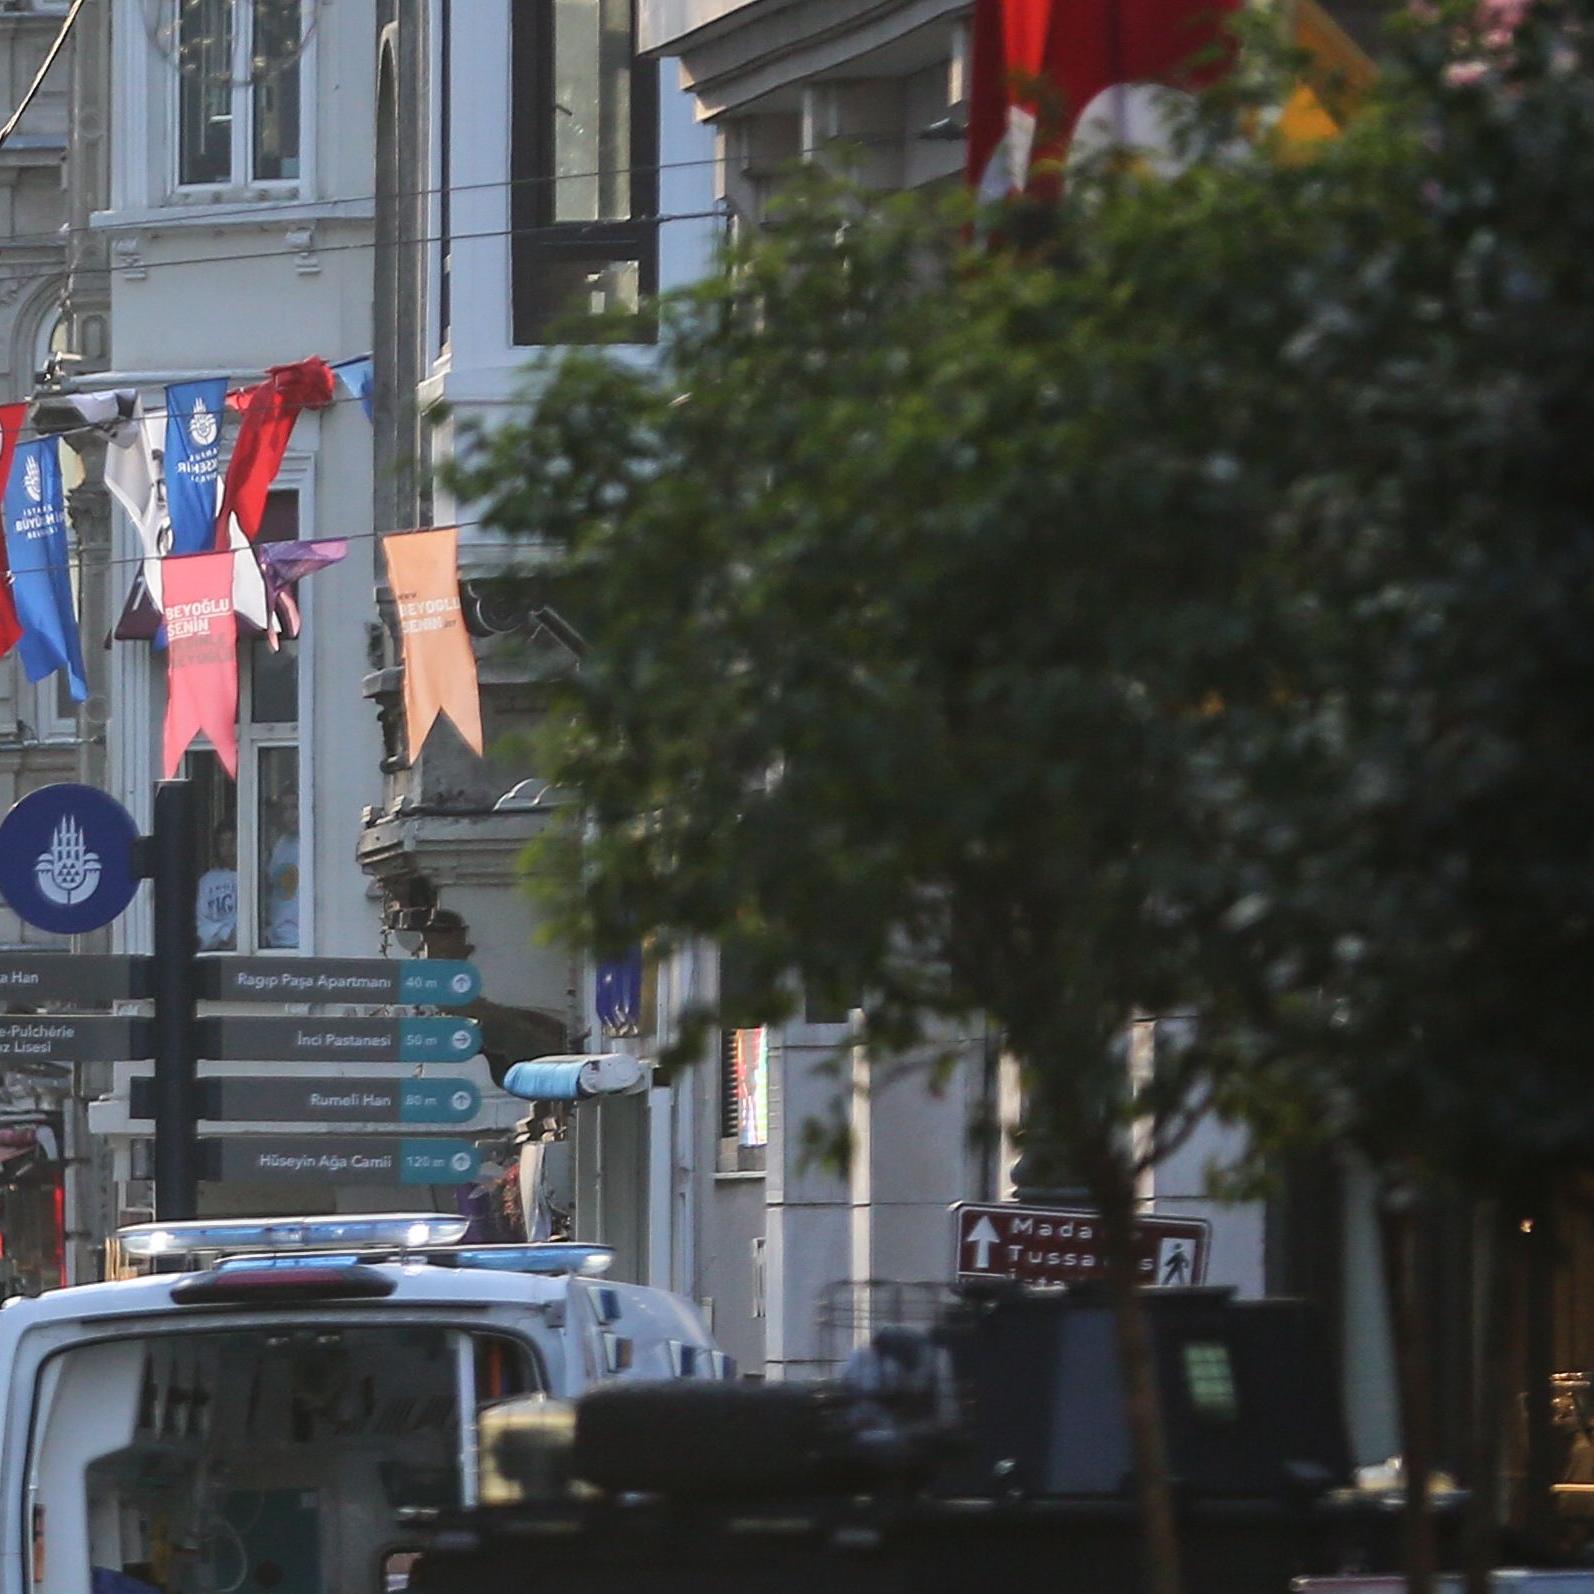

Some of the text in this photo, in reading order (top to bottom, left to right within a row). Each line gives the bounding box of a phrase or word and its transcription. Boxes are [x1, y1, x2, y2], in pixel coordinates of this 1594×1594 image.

[166, 598, 229, 620] BEYOĞLU
[167, 616, 209, 637] SENİN
[11, 971, 39, 984] Han
[282, 974, 314, 991] Paşa
[317, 974, 391, 991] Apartmanı
[406, 977, 423, 988] 40
[425, 979, 438, 989] m
[13, 1040, 52, 1054] Lisesi
[298, 1030, 438, 1047] İnci Pastanesi 50 m
[311, 1093, 437, 1107] Rumeli Han 80 m
[260, 1154, 445, 1171] Hüseyin Ağa Camii 120 m
[1008, 1244, 1155, 1271] Tussas
